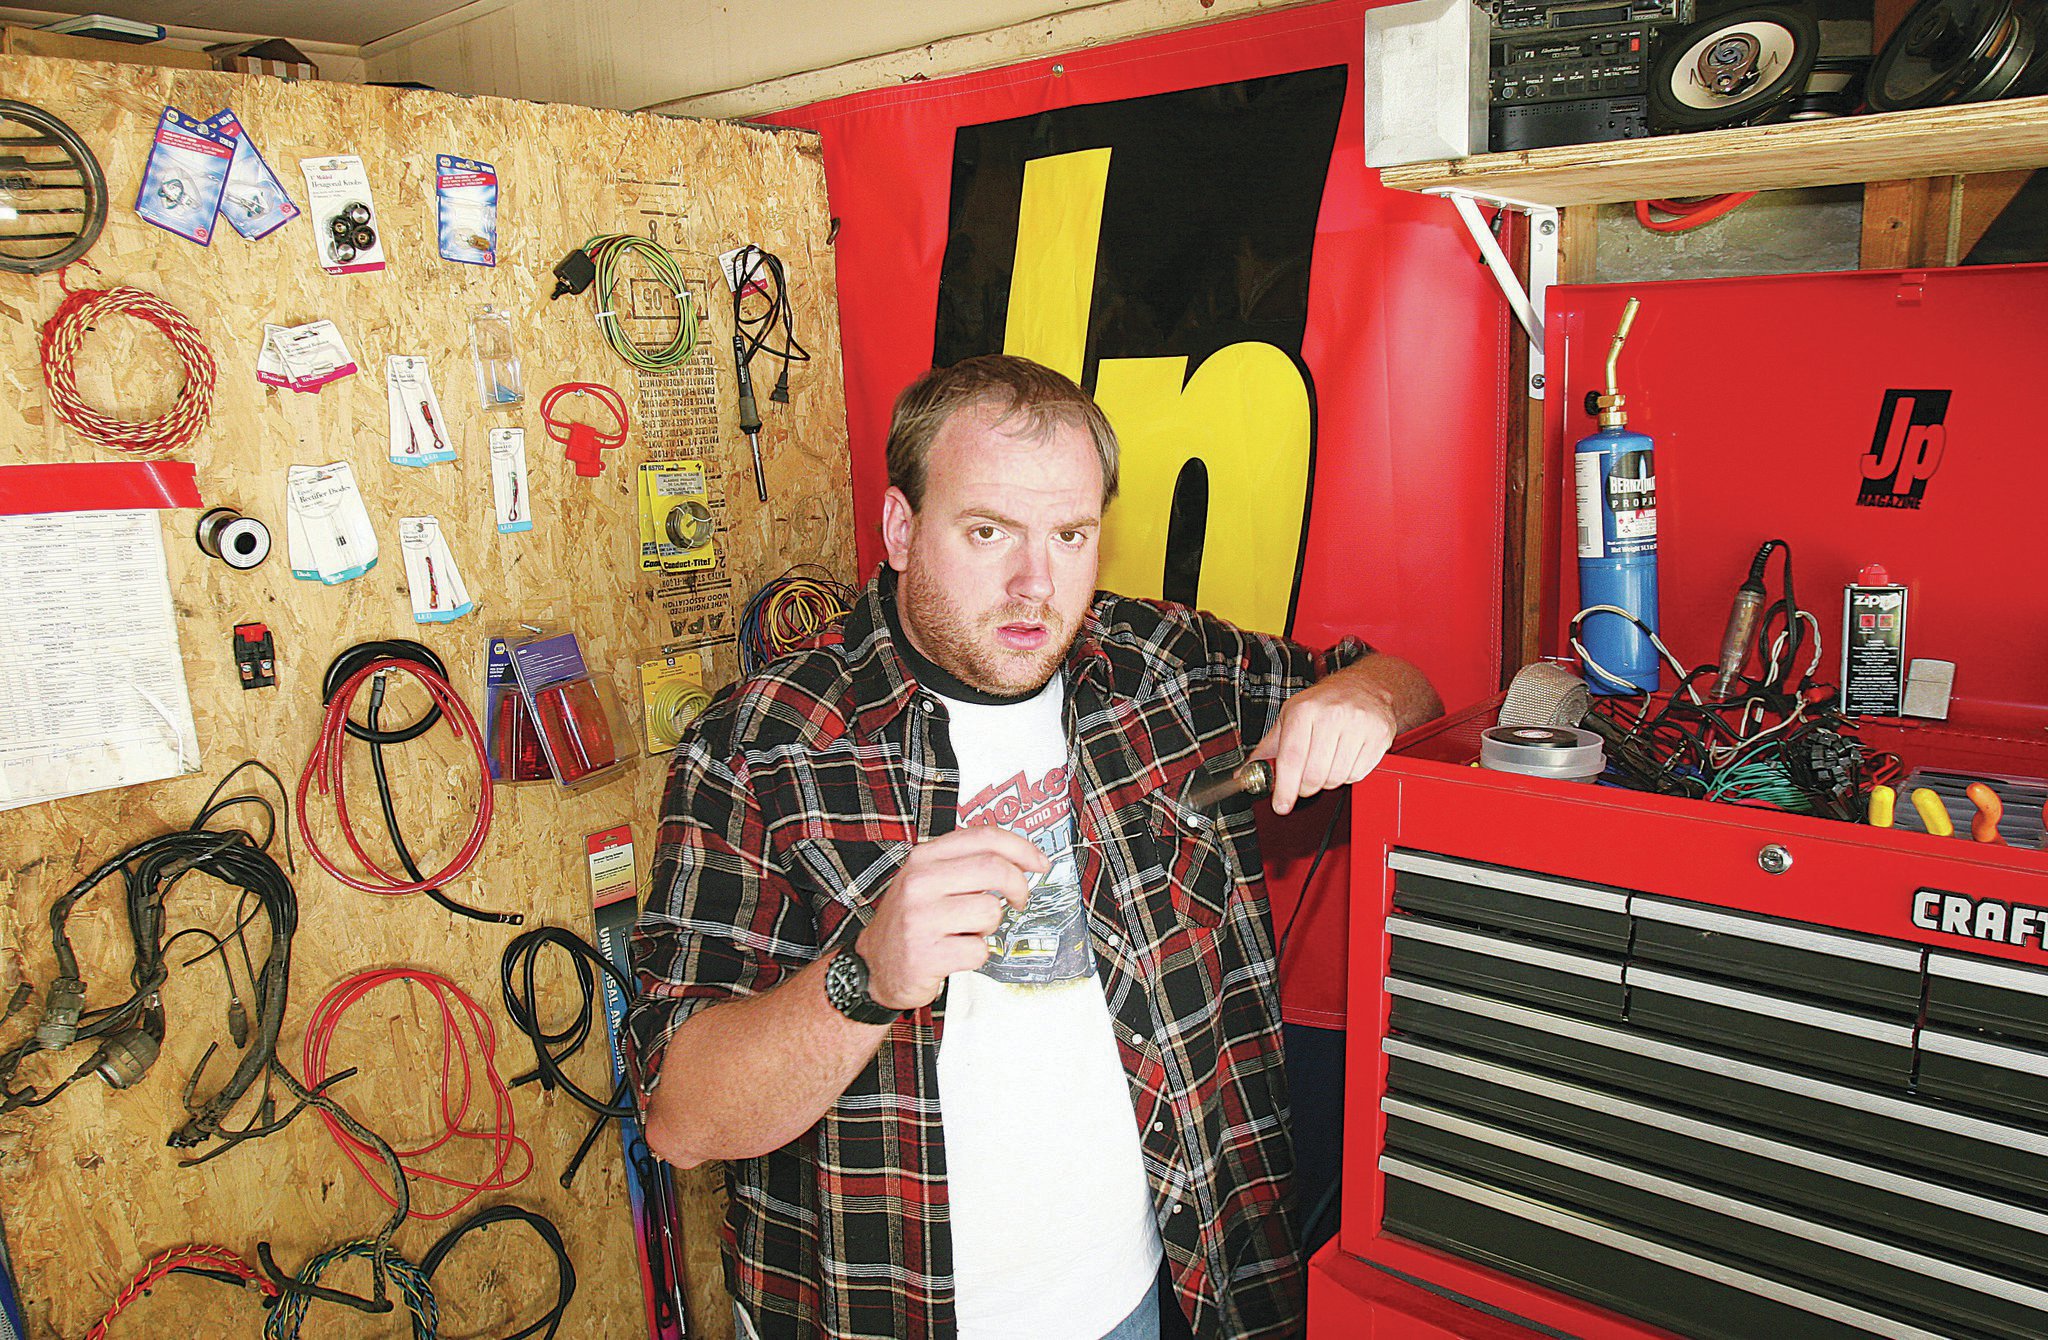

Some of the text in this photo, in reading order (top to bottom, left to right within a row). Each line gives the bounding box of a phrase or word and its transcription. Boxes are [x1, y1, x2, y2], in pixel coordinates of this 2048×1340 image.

[686, 376, 715, 386] SEPARATE
[672, 398, 694, 407] BEFORE
[698, 436, 720, 445] PANELS
[1859, 396, 1946, 495] Jp
[299, 490, 328, 503] Rectifier
[1856, 494, 1922, 511] MAGAZINE
[662, 592, 729, 609] WOOD ASSOCIATION
[1025, 800, 1070, 829] AND TH
